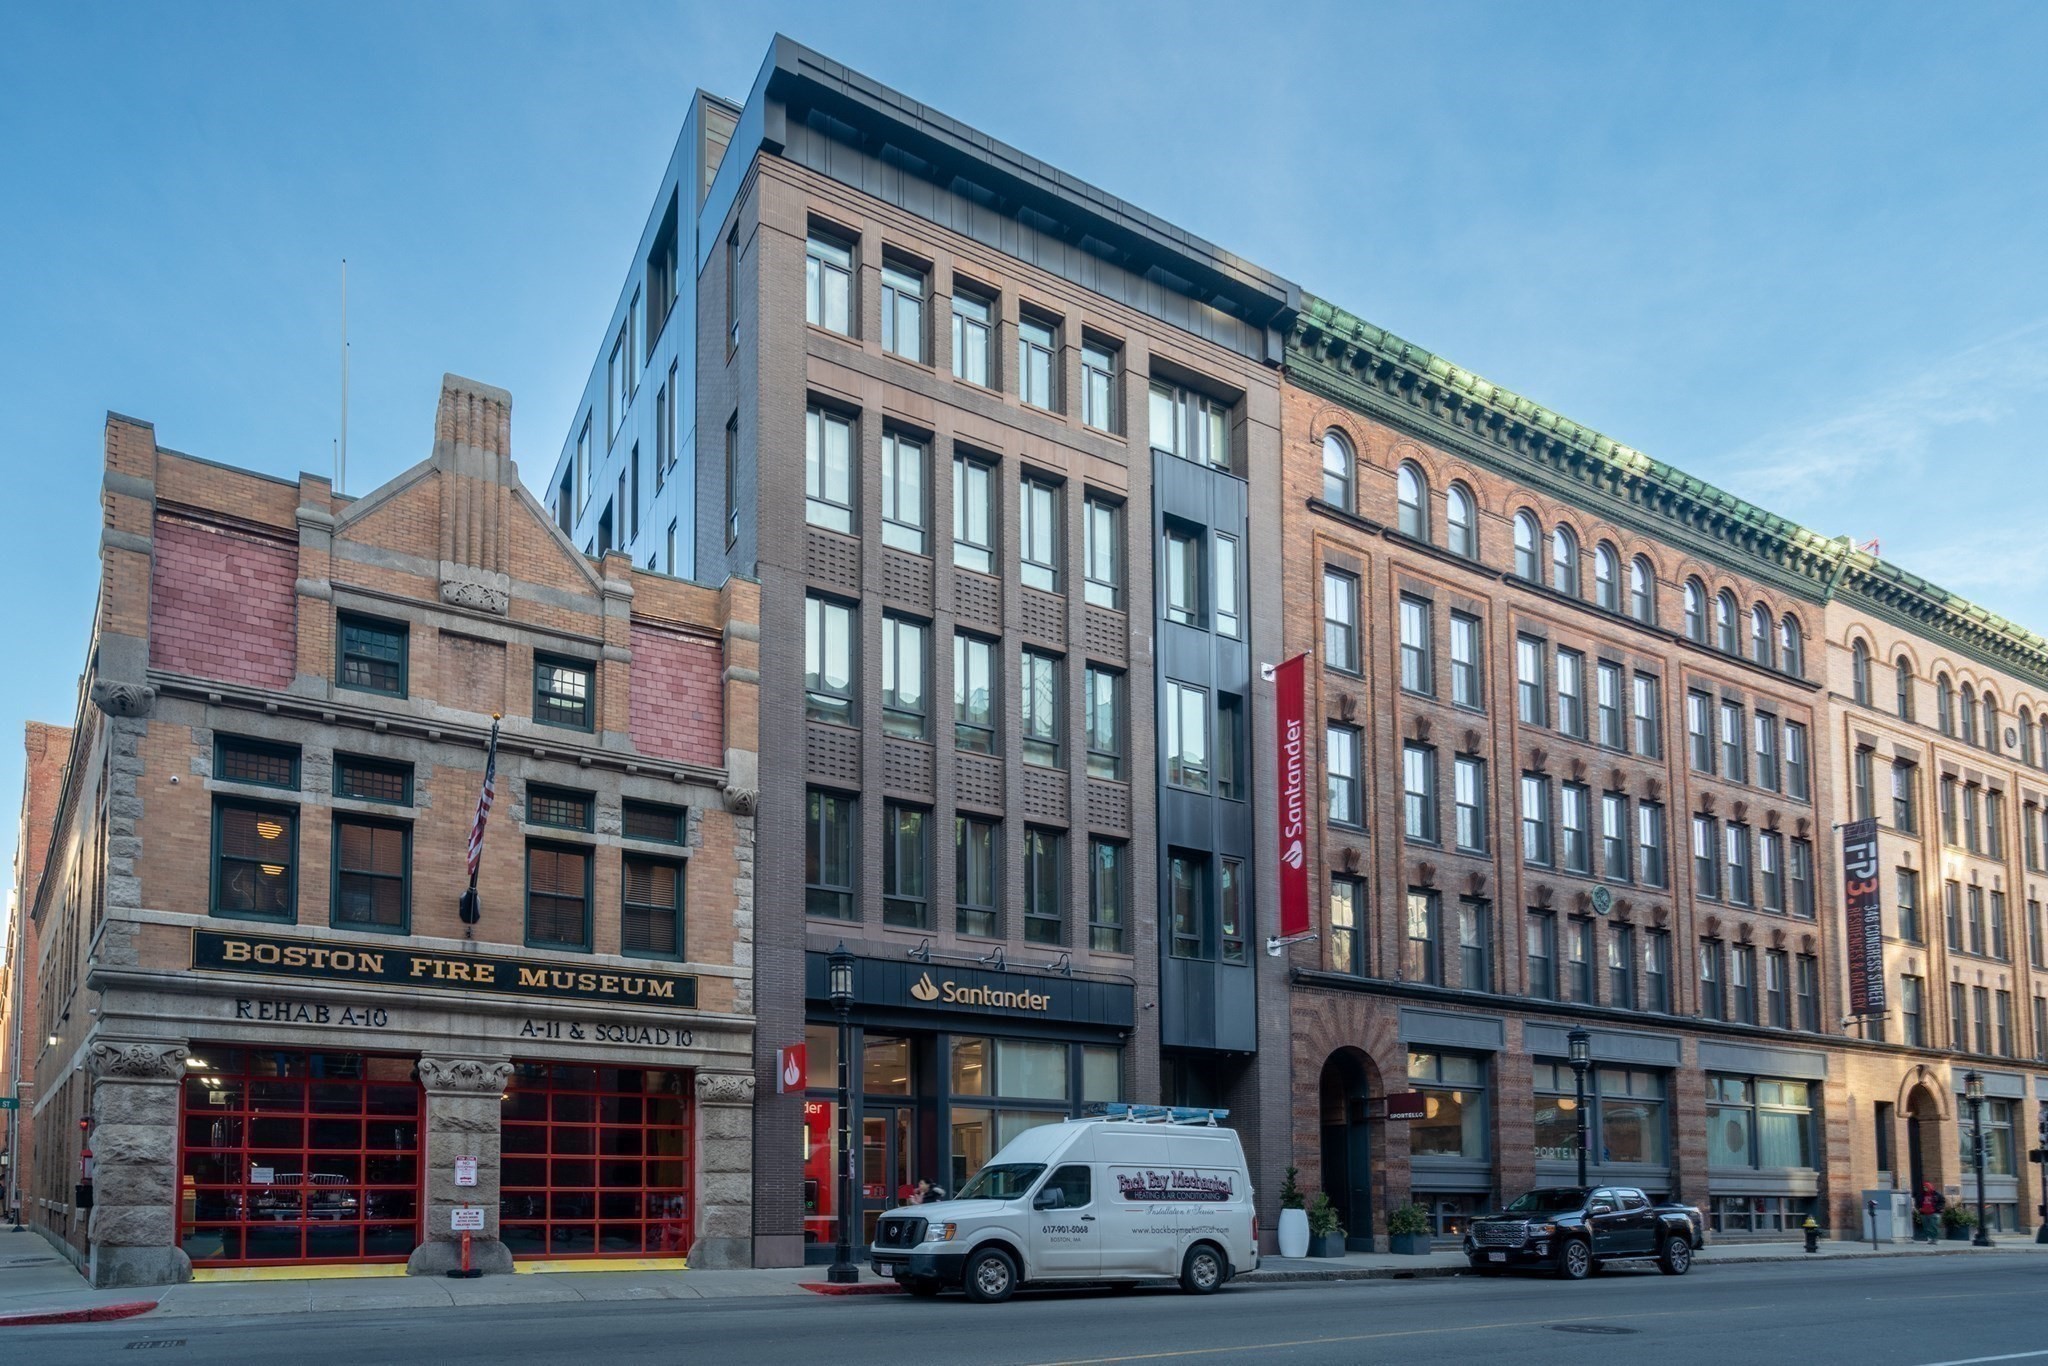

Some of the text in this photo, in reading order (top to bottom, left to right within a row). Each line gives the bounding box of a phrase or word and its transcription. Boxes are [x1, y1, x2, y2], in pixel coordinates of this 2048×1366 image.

[1284, 720, 1302, 838] Santander
[1848, 907, 1864, 960] RESIDENCES
[223, 940, 675, 998] BOSTON FIRE MUSEUM
[1864, 904, 1884, 1006] 346 CONGRESS STREET
[942, 980, 1050, 1010] Santander
[1850, 972, 1866, 1008] GALLERY
[236, 1000, 388, 1028] REHAB A-10
[520, 1020, 693, 1047] A-11 & SQUAD 10
[1117, 1170, 1233, 1195] Back Bay Mechanical
[1144, 1204, 1184, 1215] Installation
[1192, 1204, 1215, 1215] Service
[1132, 1225, 1229, 1236] www.backbaymechanical.com
